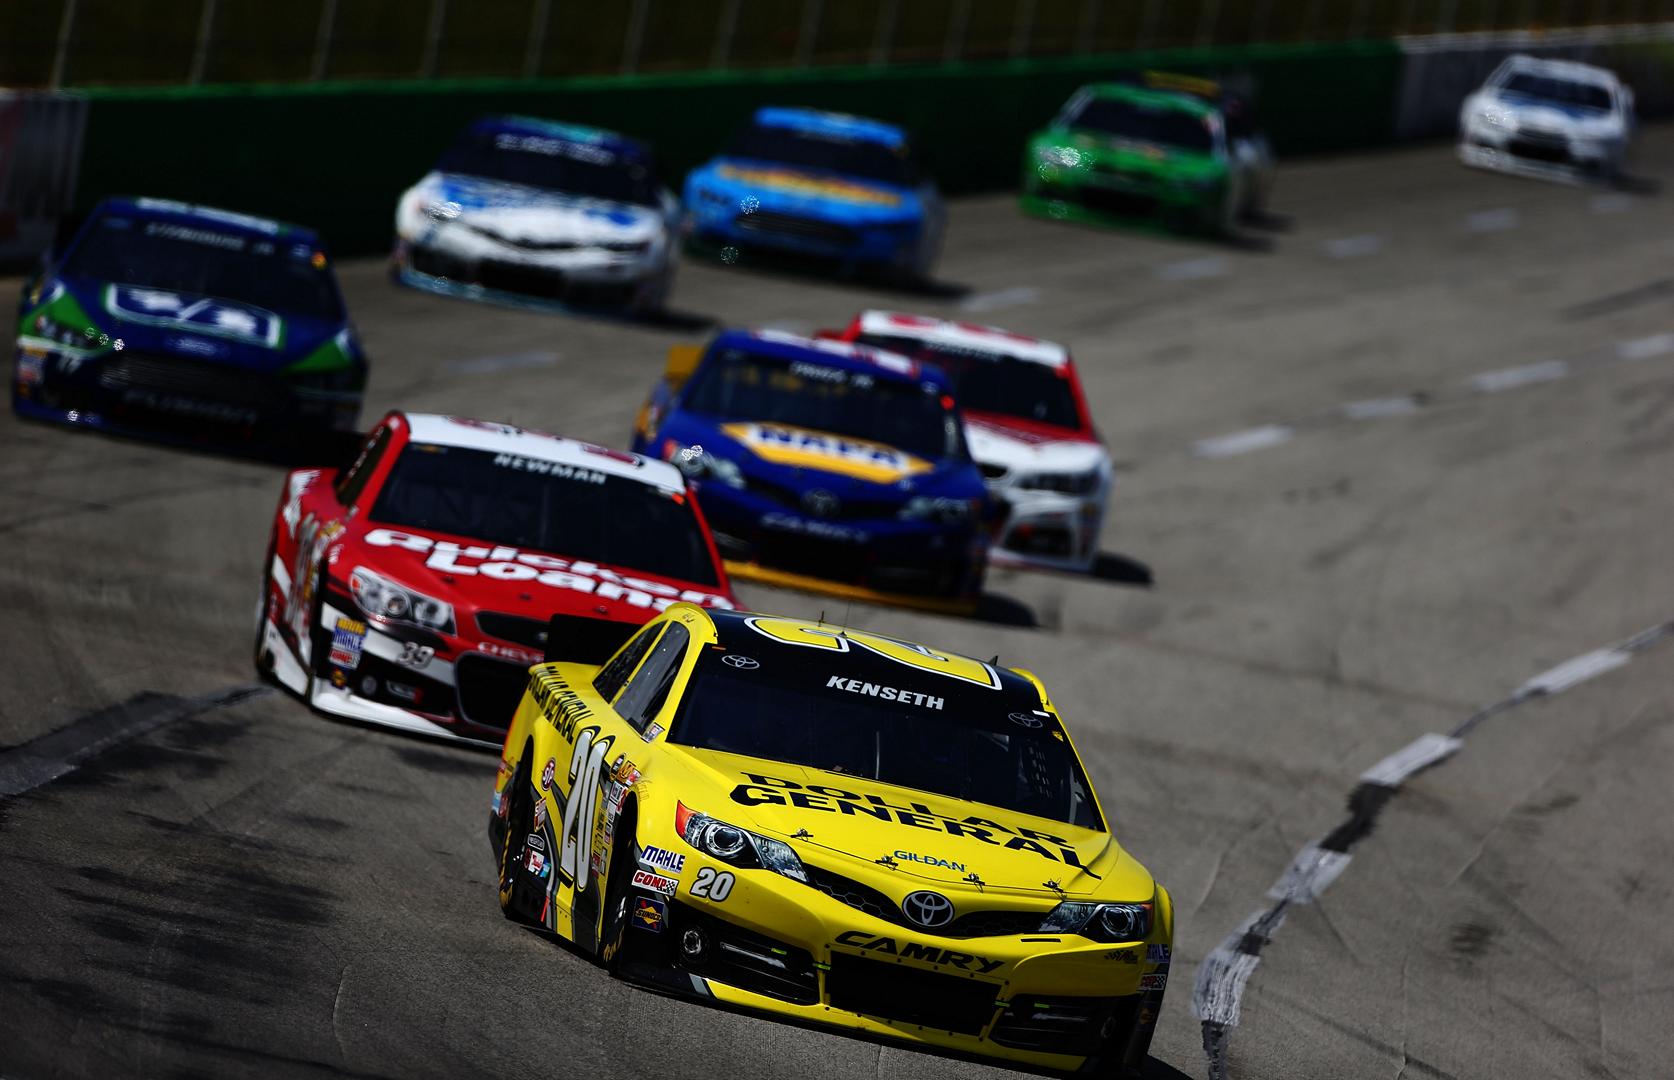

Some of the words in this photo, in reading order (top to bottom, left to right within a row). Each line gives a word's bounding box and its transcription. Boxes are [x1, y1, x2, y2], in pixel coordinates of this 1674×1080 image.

[493, 452, 608, 486] NEWMAN
[363, 528, 735, 611] Quicken
[400, 641, 436, 670] 39
[826, 673, 945, 712] KENSETH
[557, 725, 615, 892] 20
[741, 772, 1076, 849] DOLLAR
[729, 783, 1102, 881] GENERAL
[641, 845, 686, 872] MAHLE
[893, 850, 966, 873] GILDAN
[634, 871, 668, 890] COMP
[690, 867, 735, 902] 20
[635, 908, 662, 921] SUNOCO
[834, 930, 1005, 973] CAMRY
